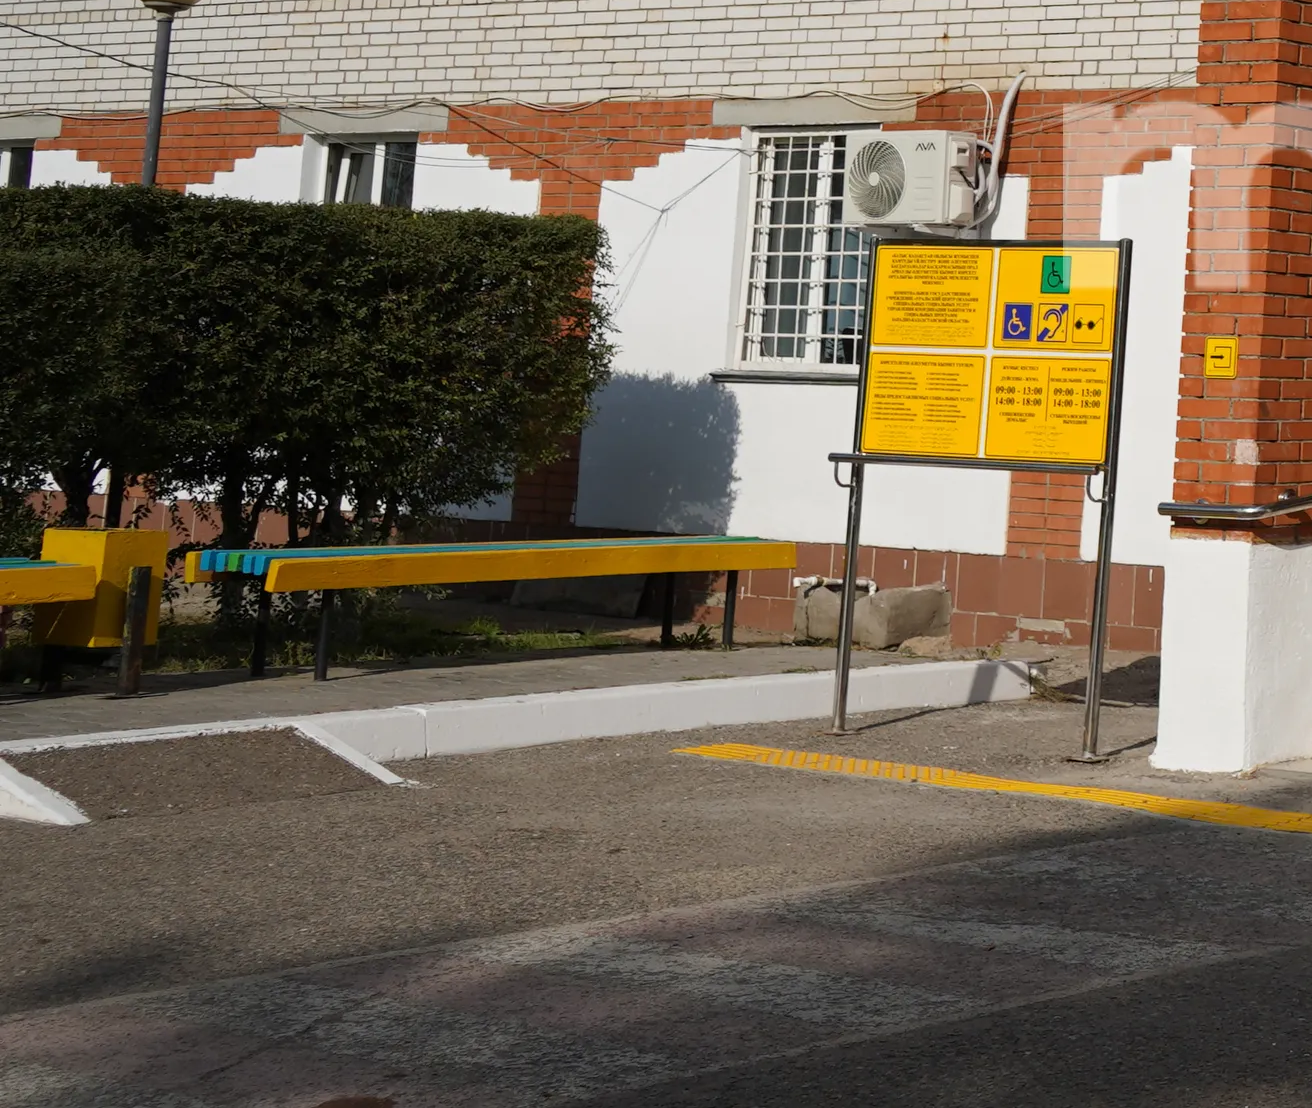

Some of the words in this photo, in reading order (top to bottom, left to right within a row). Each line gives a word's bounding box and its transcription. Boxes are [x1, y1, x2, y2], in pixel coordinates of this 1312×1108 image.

[995, 386, 1016, 395] 09:00
[1022, 387, 1043, 395] 13:00
[1053, 388, 1074, 397] 09:00
[1081, 389, 1102, 397] 13:00
[995, 397, 1015, 406] 14:00
[1022, 398, 1042, 406] 18:00
[1053, 399, 1073, 408] 14:00
[1080, 400, 1101, 408] 18:00
